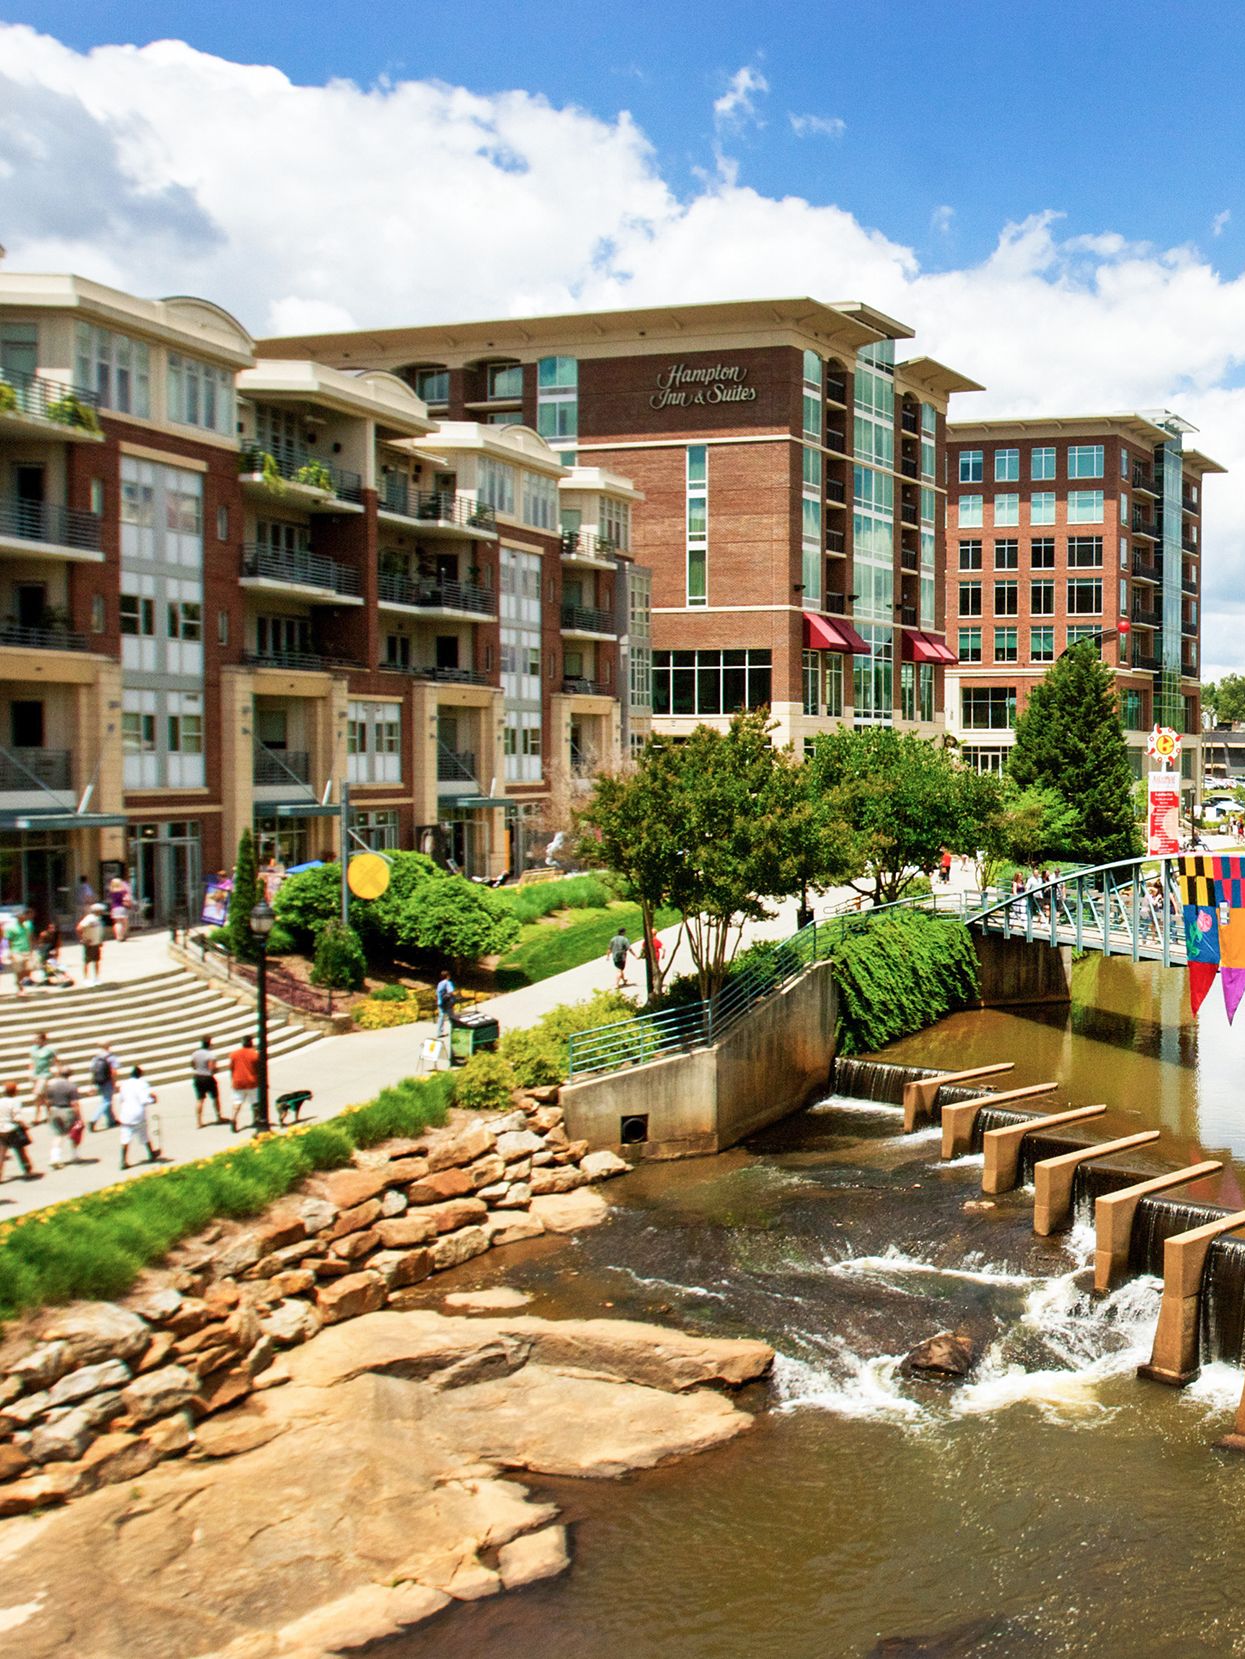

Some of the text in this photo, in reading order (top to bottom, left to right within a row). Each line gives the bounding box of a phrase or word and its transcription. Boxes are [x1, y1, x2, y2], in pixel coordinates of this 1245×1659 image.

[657, 364, 747, 389] Hampton
[649, 384, 756, 409] Inn & Suites
